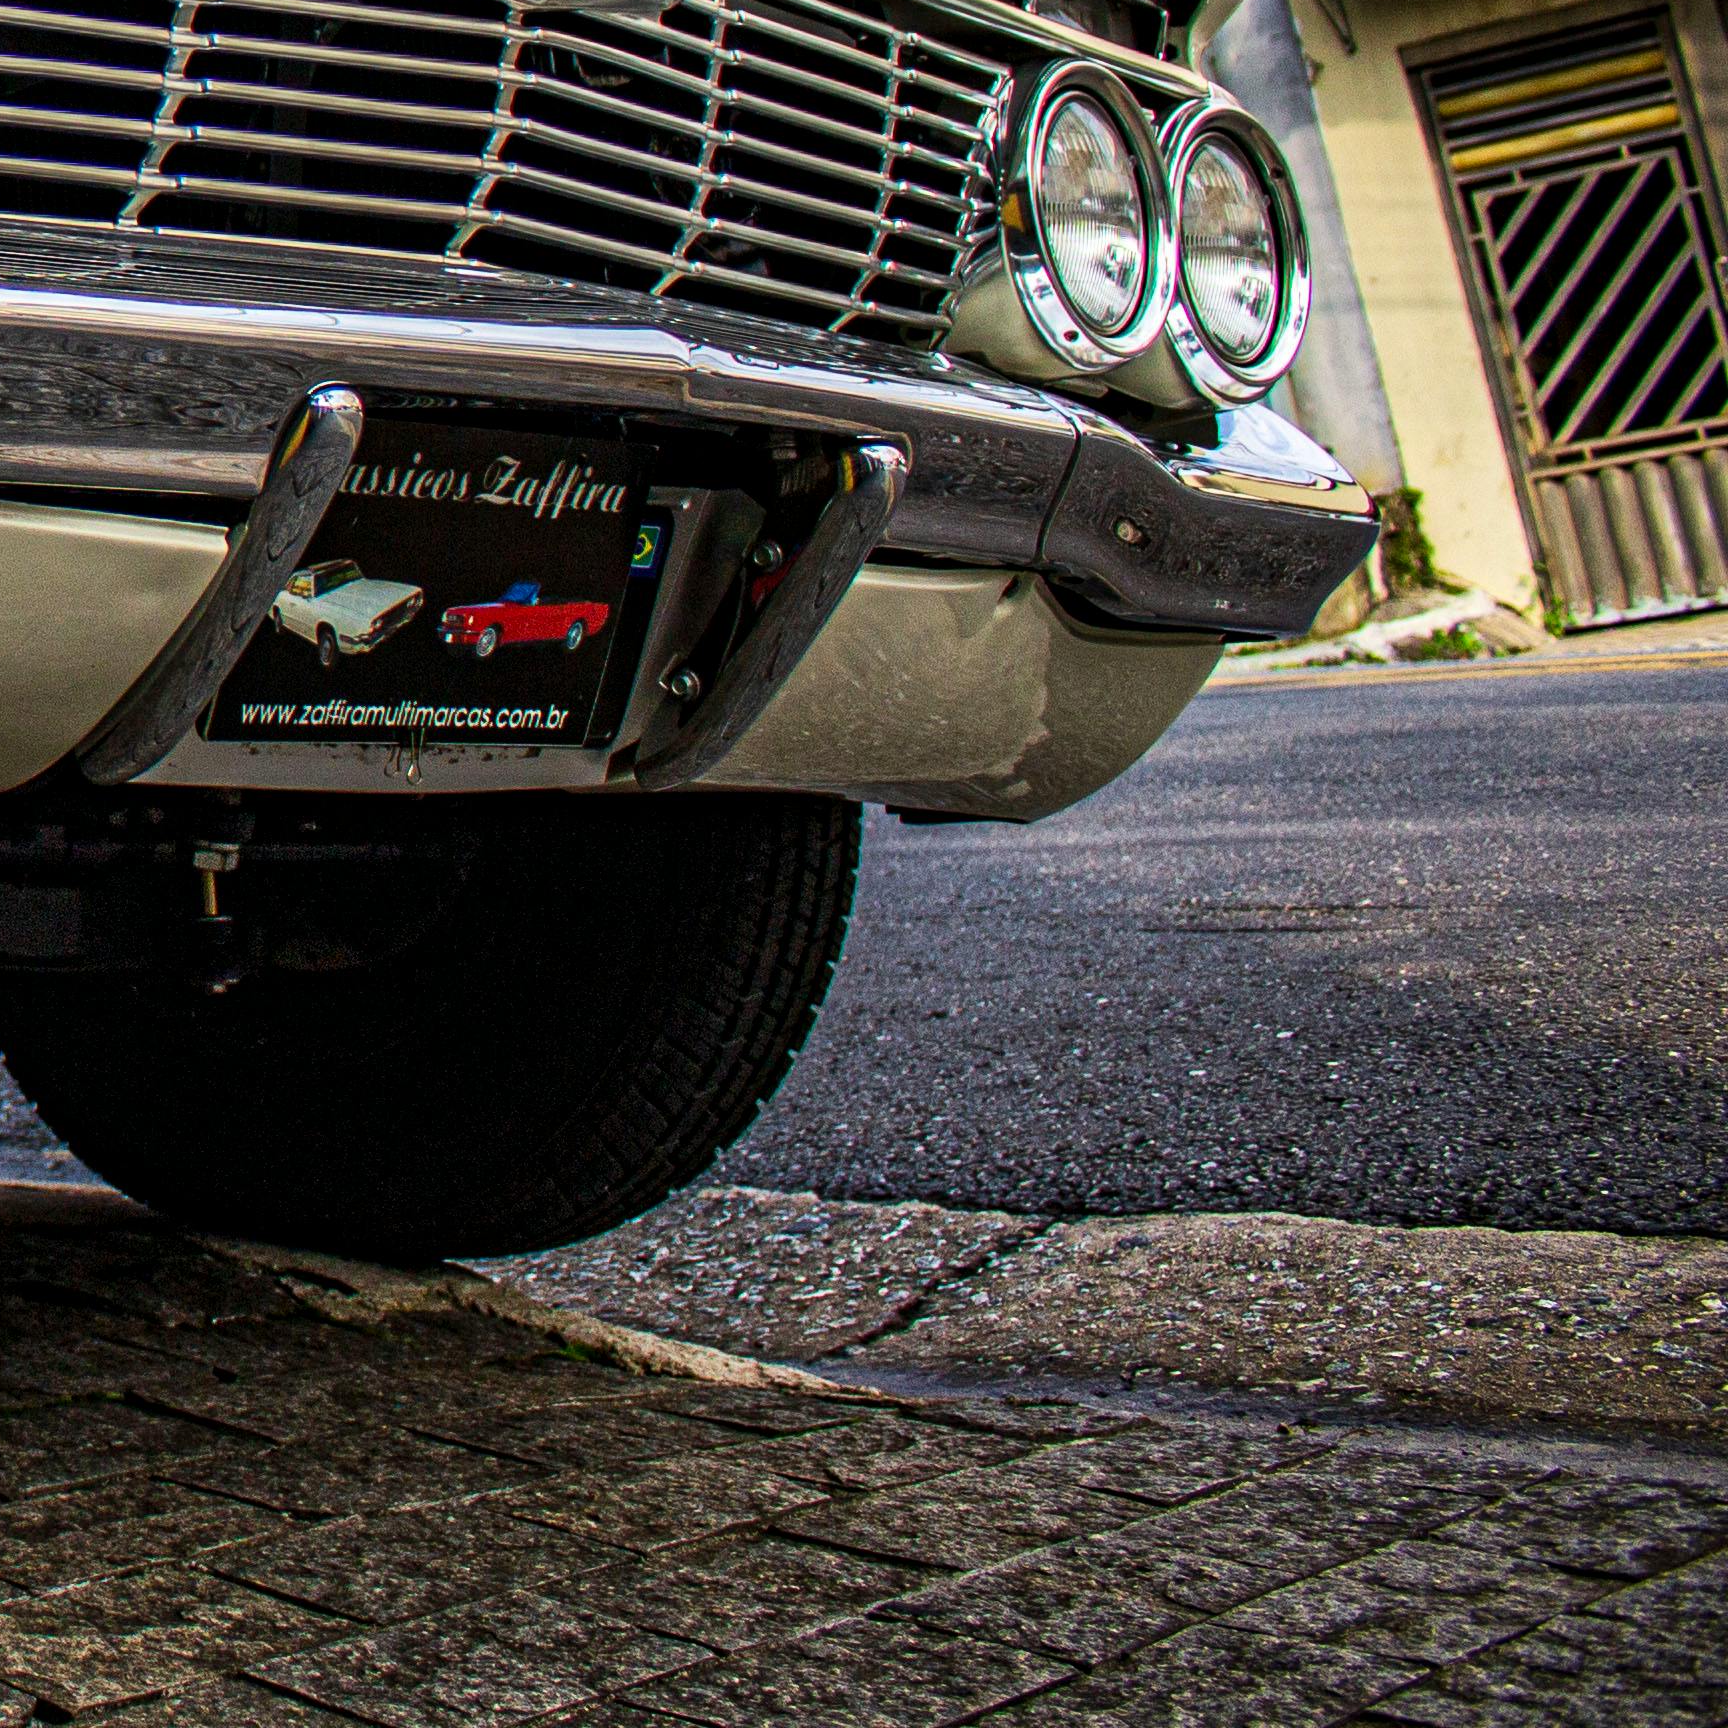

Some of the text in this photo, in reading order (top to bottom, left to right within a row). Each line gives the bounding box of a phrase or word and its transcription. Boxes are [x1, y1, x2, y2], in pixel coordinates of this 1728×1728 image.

[339, 451, 628, 520] assicos Zaffira
[241, 699, 569, 729] www.zaffiramultimarcas.com.br
